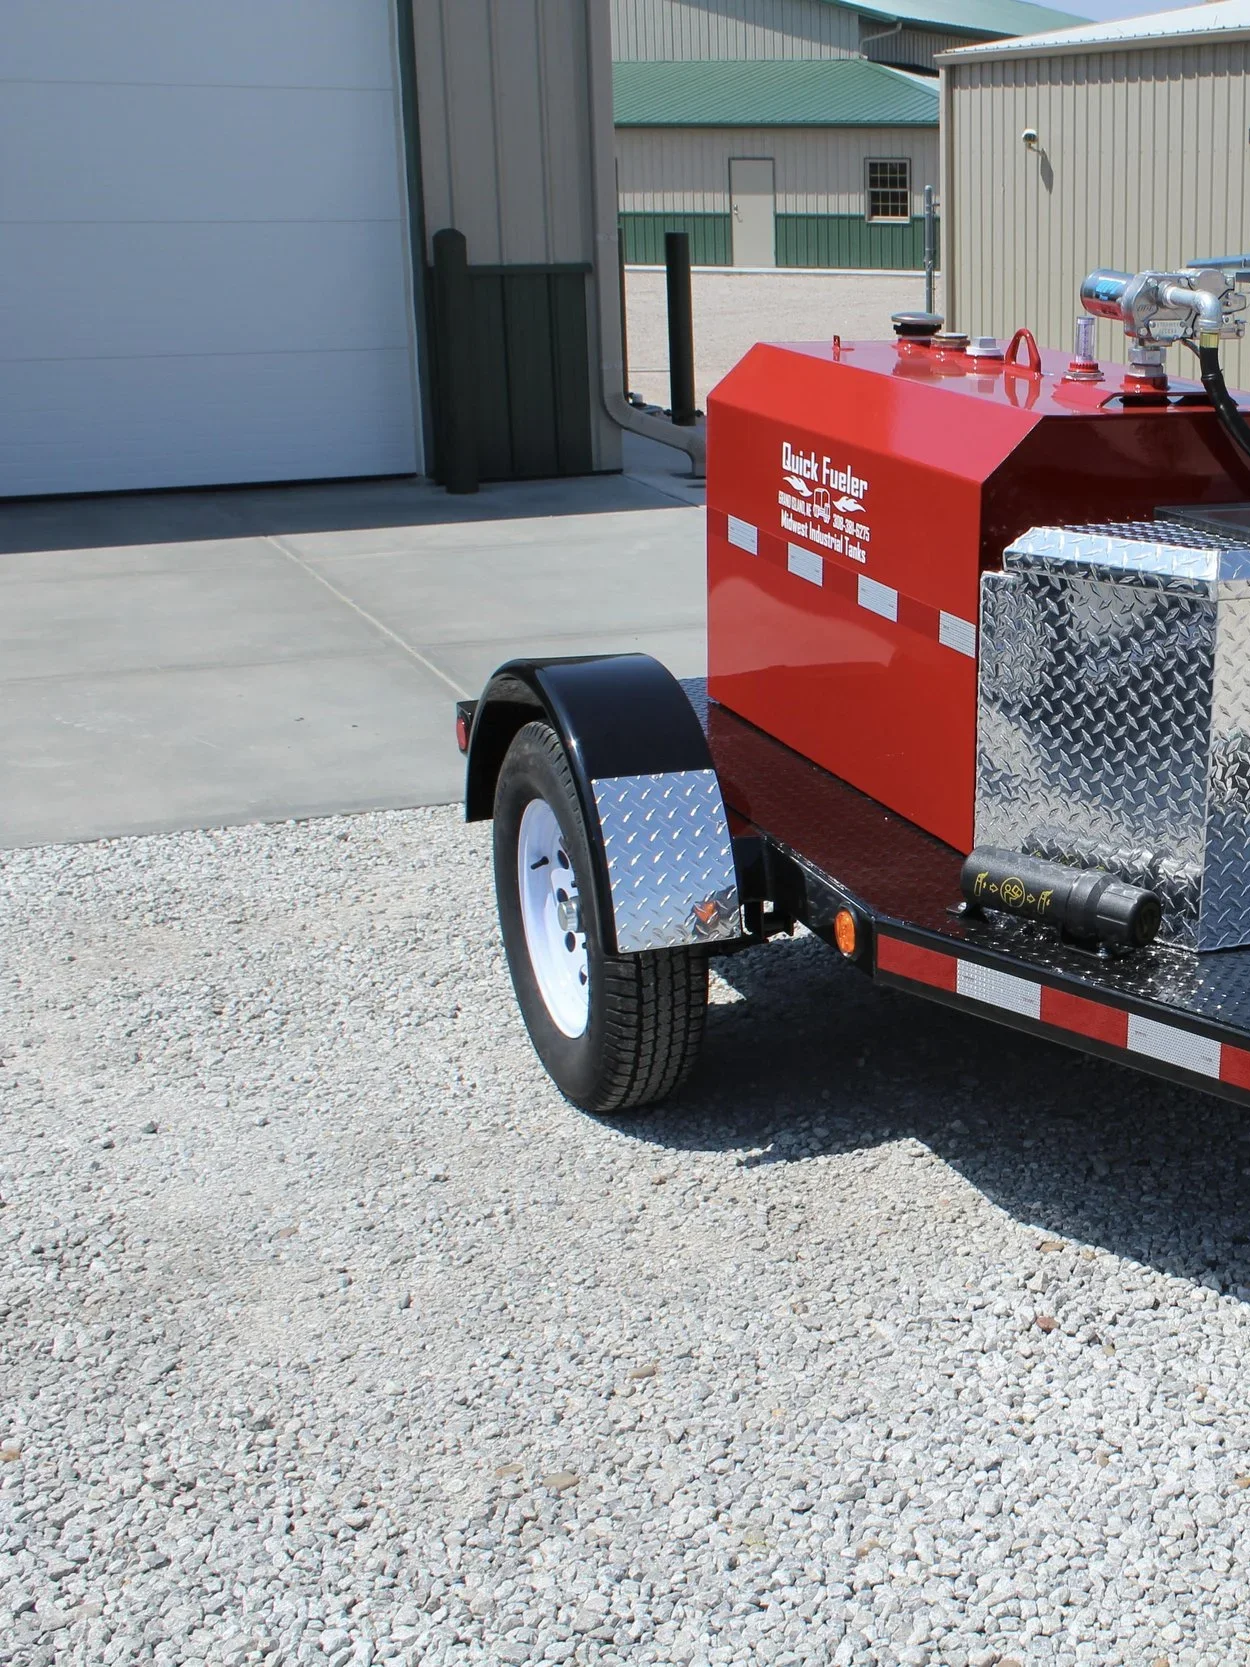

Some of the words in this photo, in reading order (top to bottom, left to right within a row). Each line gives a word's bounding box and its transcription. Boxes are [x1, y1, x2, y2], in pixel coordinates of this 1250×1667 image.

[782, 441, 819, 482] Quick
[822, 456, 868, 499] Fueler
[781, 509, 808, 538] Midwest
[809, 521, 843, 553] Industrial
[844, 536, 866, 564] Tanks
